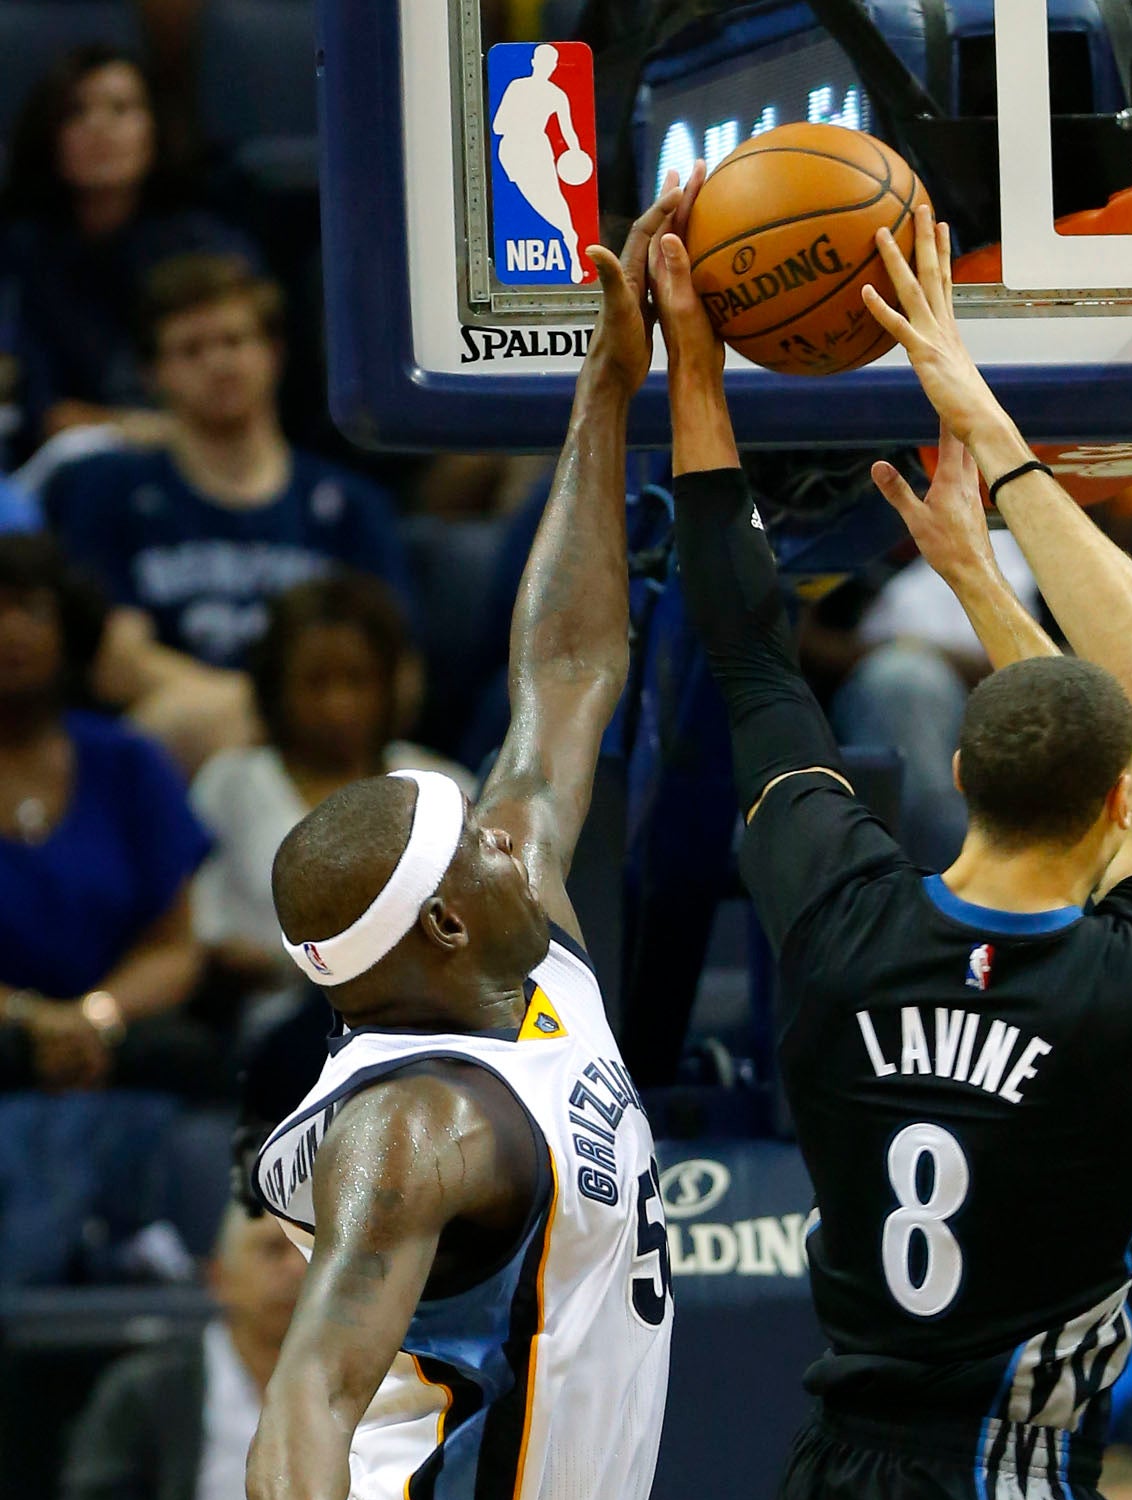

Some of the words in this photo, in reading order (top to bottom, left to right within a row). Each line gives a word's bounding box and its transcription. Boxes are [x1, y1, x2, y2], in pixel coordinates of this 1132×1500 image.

[506, 239, 566, 272] NBA
[856, 1006, 1053, 1104] LAVINE
[631, 1154, 673, 1326] 5
[667, 1212, 808, 1277] LDIN
[881, 1122, 970, 1317] 8
